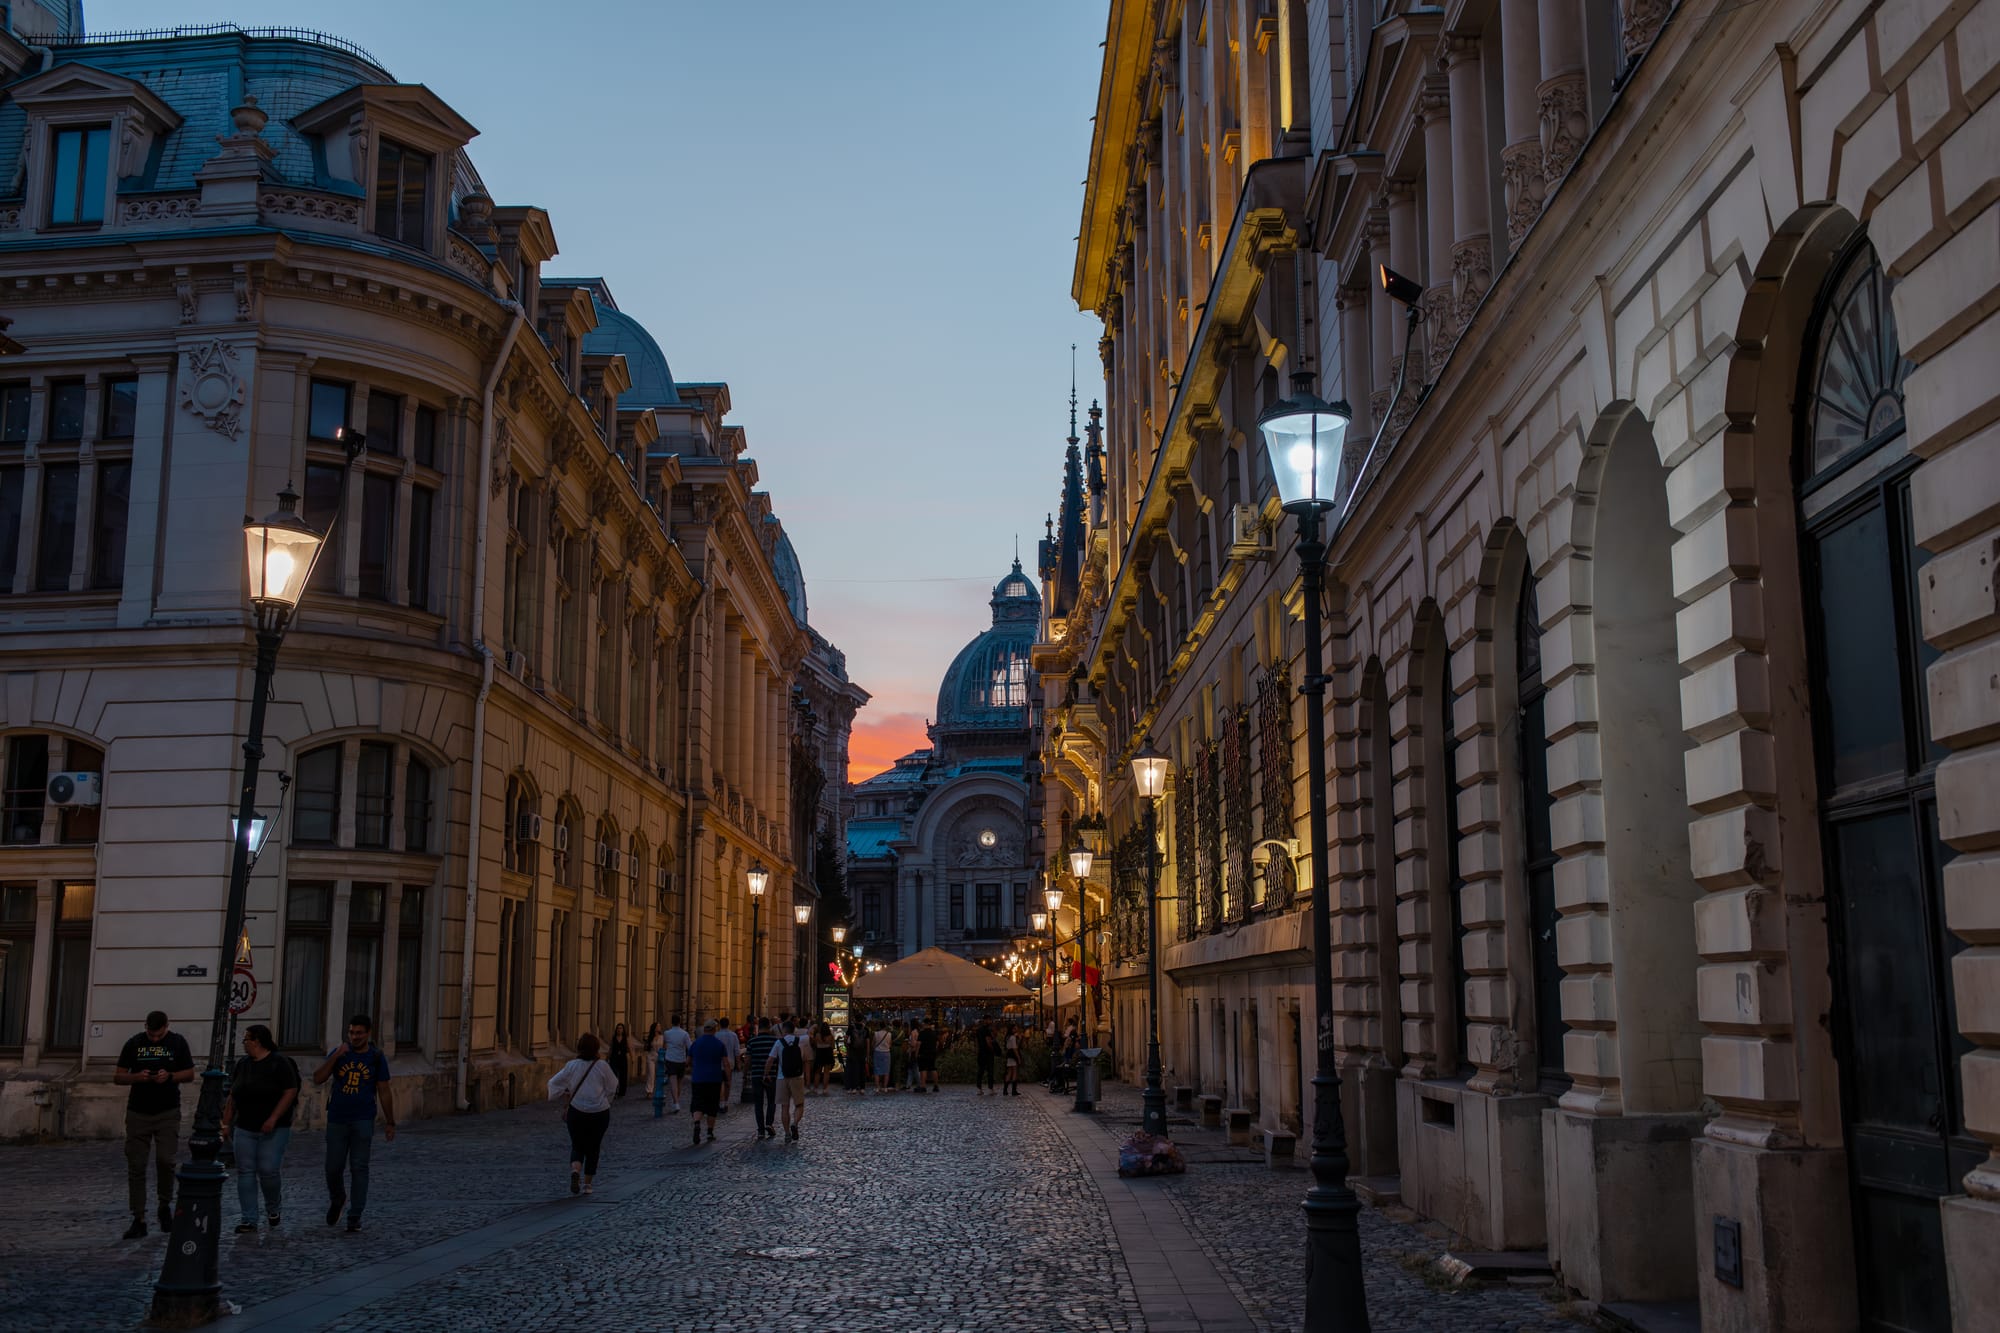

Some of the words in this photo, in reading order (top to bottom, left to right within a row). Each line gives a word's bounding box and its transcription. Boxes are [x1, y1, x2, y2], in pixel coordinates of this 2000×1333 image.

[230, 981, 249, 1001] 30
[338, 1061, 355, 1077] MILE
[347, 1071, 360, 1085] 15
[342, 1084, 358, 1094] CITY
